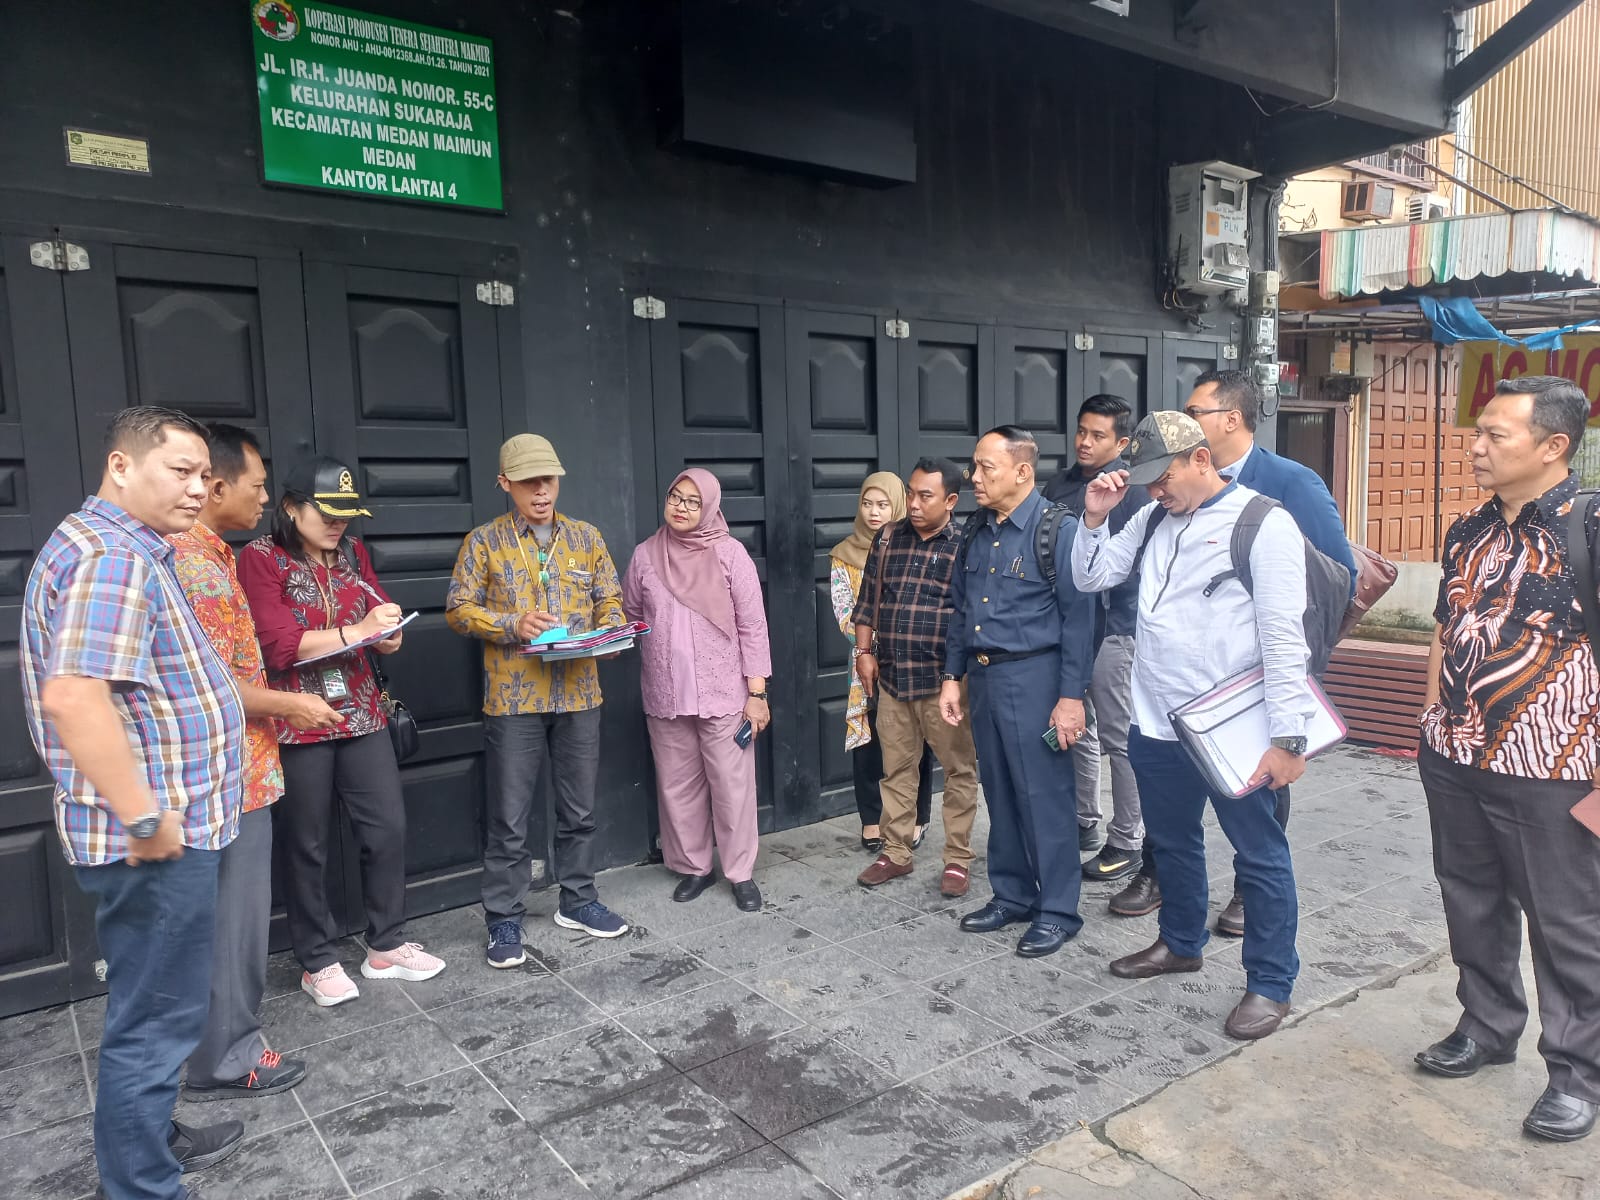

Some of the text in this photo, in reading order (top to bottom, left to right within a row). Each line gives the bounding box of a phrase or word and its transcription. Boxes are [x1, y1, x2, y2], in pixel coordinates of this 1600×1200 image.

[304, 7, 490, 64] KOPERASI PRODUSEN TENERA SEJAHTERA MAKMUR
[310, 31, 341, 48] NOMOR
[342, 38, 359, 52] AHU
[448, 59, 473, 75] TAHUN
[473, 64, 490, 78] 2021
[260, 52, 494, 112] JL. IR.H. JUANDA NOMOR. 55-C
[290, 84, 473, 132] KELURAHAN SUKARAJA
[271, 106, 492, 158] KECAMATAN MEDAN MAIMUN
[362, 147, 416, 171] MEDAN
[321, 166, 458, 200] KANTOR LANTAI 4
[1223, 220, 1239, 233] PLN
